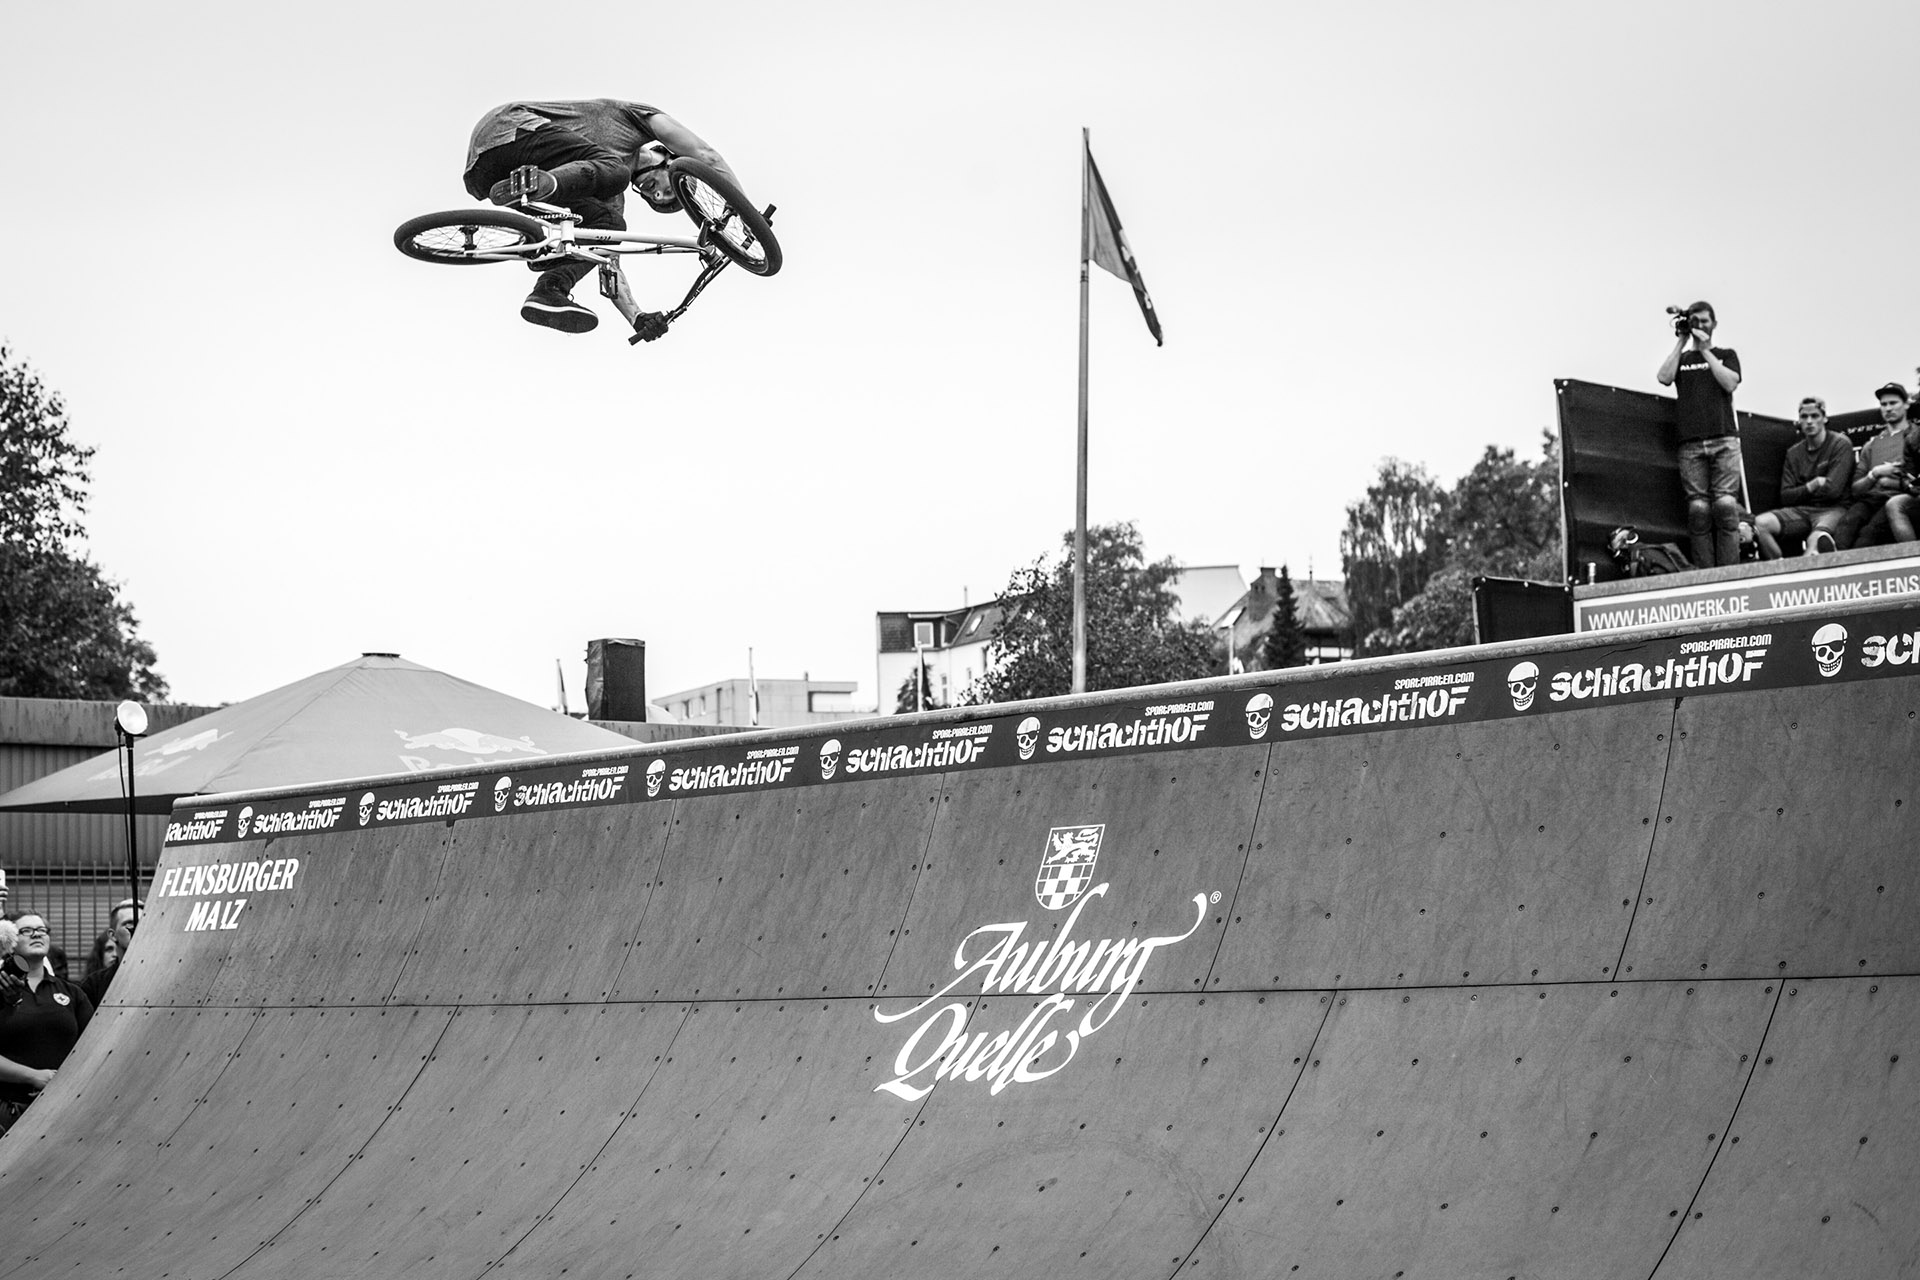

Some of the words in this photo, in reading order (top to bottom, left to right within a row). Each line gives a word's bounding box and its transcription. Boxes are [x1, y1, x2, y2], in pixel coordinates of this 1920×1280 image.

[1588, 596, 1750, 630] WWW.HANDWERK.DE
[158, 858, 299, 897] FLENSBURGER
[184, 899, 247, 932] MALZ
[874, 882, 1207, 1037] Auburg
[873, 993, 1080, 1102] Quelle
